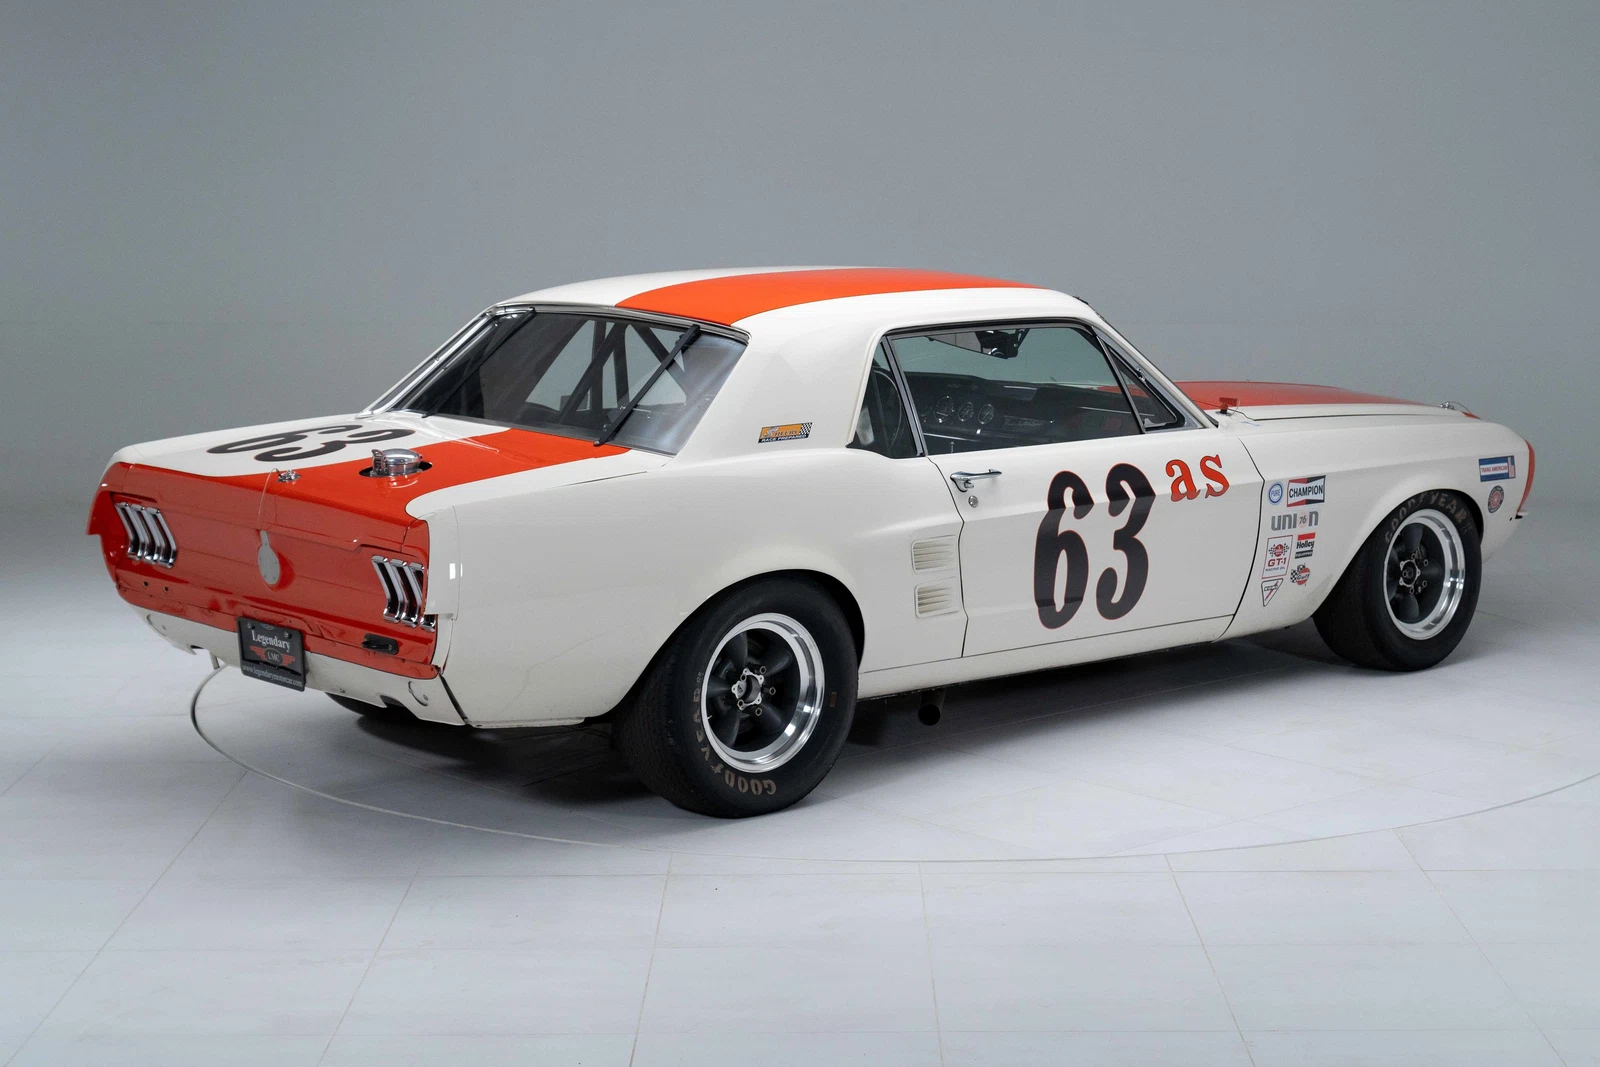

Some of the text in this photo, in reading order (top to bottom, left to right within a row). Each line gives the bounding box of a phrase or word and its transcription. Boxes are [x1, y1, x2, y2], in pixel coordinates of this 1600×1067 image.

[206, 424, 416, 462] 63
[1165, 454, 1230, 502] as
[1288, 485, 1324, 498] CHAMPION
[1034, 463, 1157, 630] 63
[1296, 540, 1315, 550] Holley
[251, 629, 290, 653] Legendary
[267, 652, 280, 662] LMC
